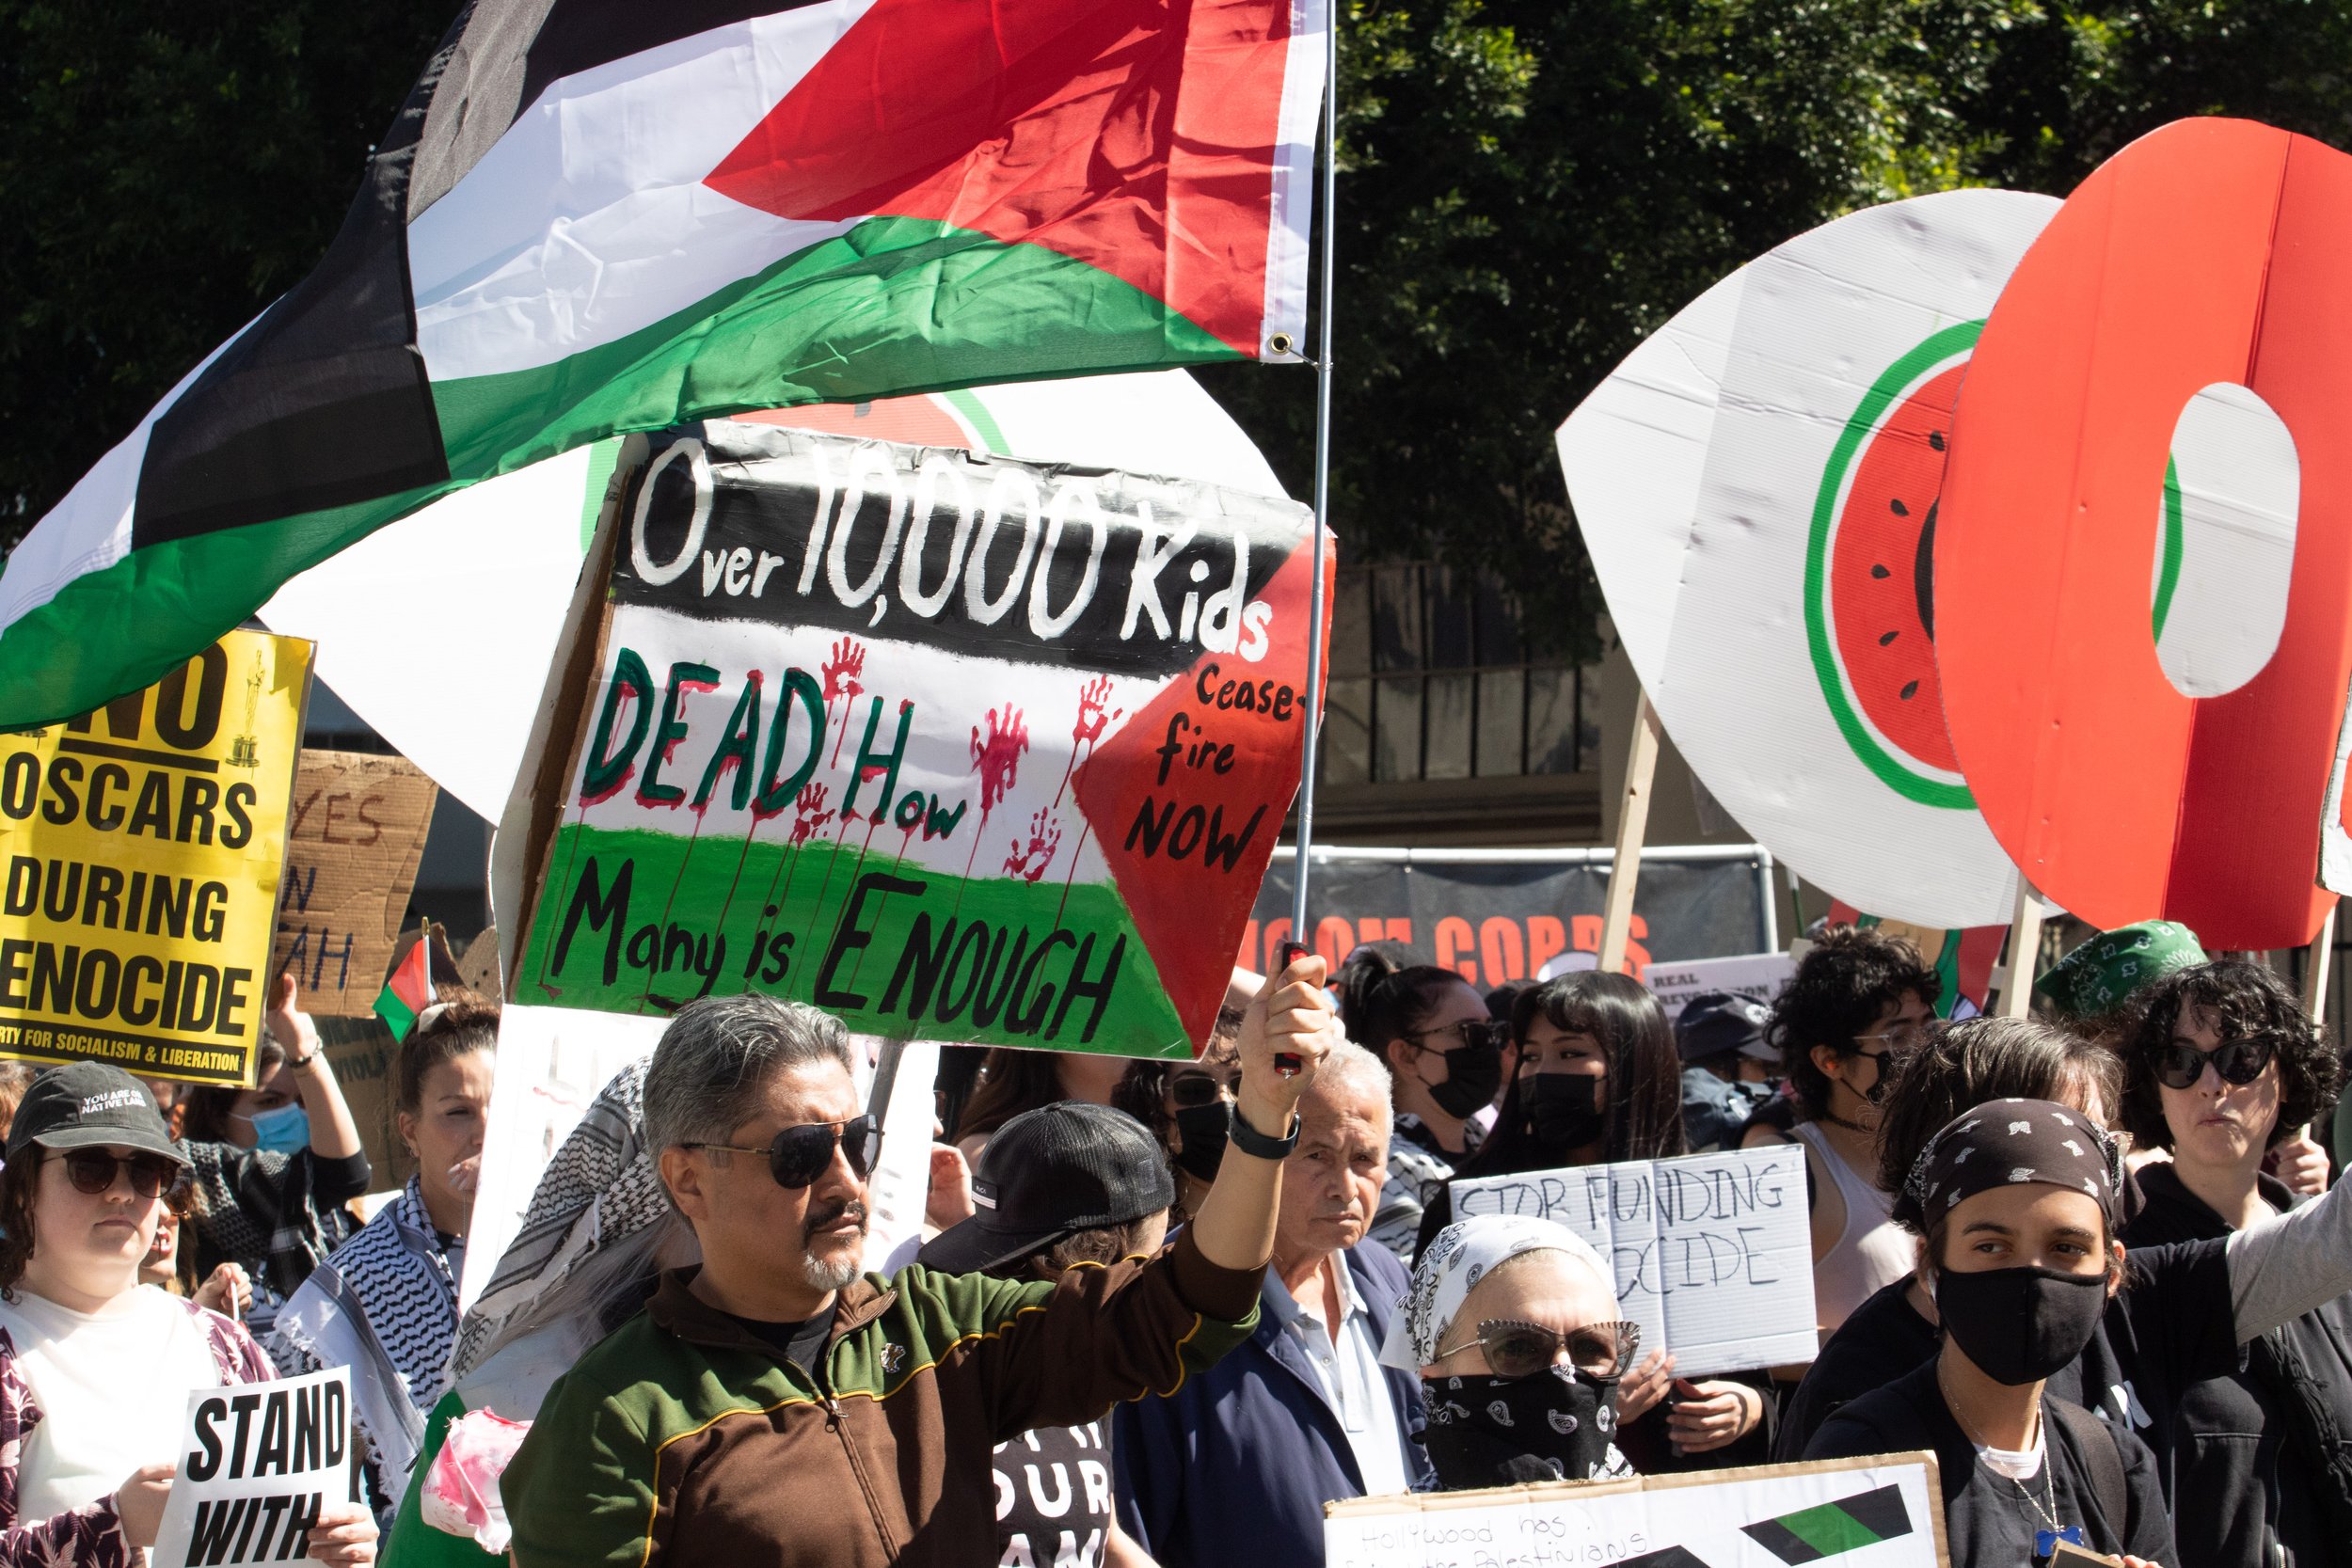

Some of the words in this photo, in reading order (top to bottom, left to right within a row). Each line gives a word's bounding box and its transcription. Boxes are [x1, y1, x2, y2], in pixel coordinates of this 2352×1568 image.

[631, 436, 785, 597] Over
[798, 444, 1107, 640] 10,000
[1120, 501, 1273, 662] Kids
[580, 647, 827, 813] DEAD
[841, 696, 966, 841] How
[1156, 712, 1235, 786] fire
[2, 752, 256, 849] OSCARS
[1124, 795, 1268, 873] NOW
[4, 855, 228, 942] DURING
[0, 939, 252, 1036] ENOCIDE
[551, 855, 726, 1011] Many
[745, 905, 795, 984] is
[816, 872, 1128, 1043] ENOUGH
[1653, 974, 1700, 988] REAL
[24, 1029, 52, 1048] FOR
[56, 1034, 141, 1060] SOCIALISM
[145, 1046, 157, 1063] &
[161, 1047, 240, 1071] LIBERATION
[82, 1098, 122, 1115] NATIVE
[83, 1092, 108, 1106] YOU
[110, 1089, 130, 1101] ARE
[1586, 1163, 1783, 1229] FUNDING
[1597, 1227, 1780, 1302] OCIDE
[187, 1380, 345, 1482] STAND
[184, 1492, 323, 1568] WITH
